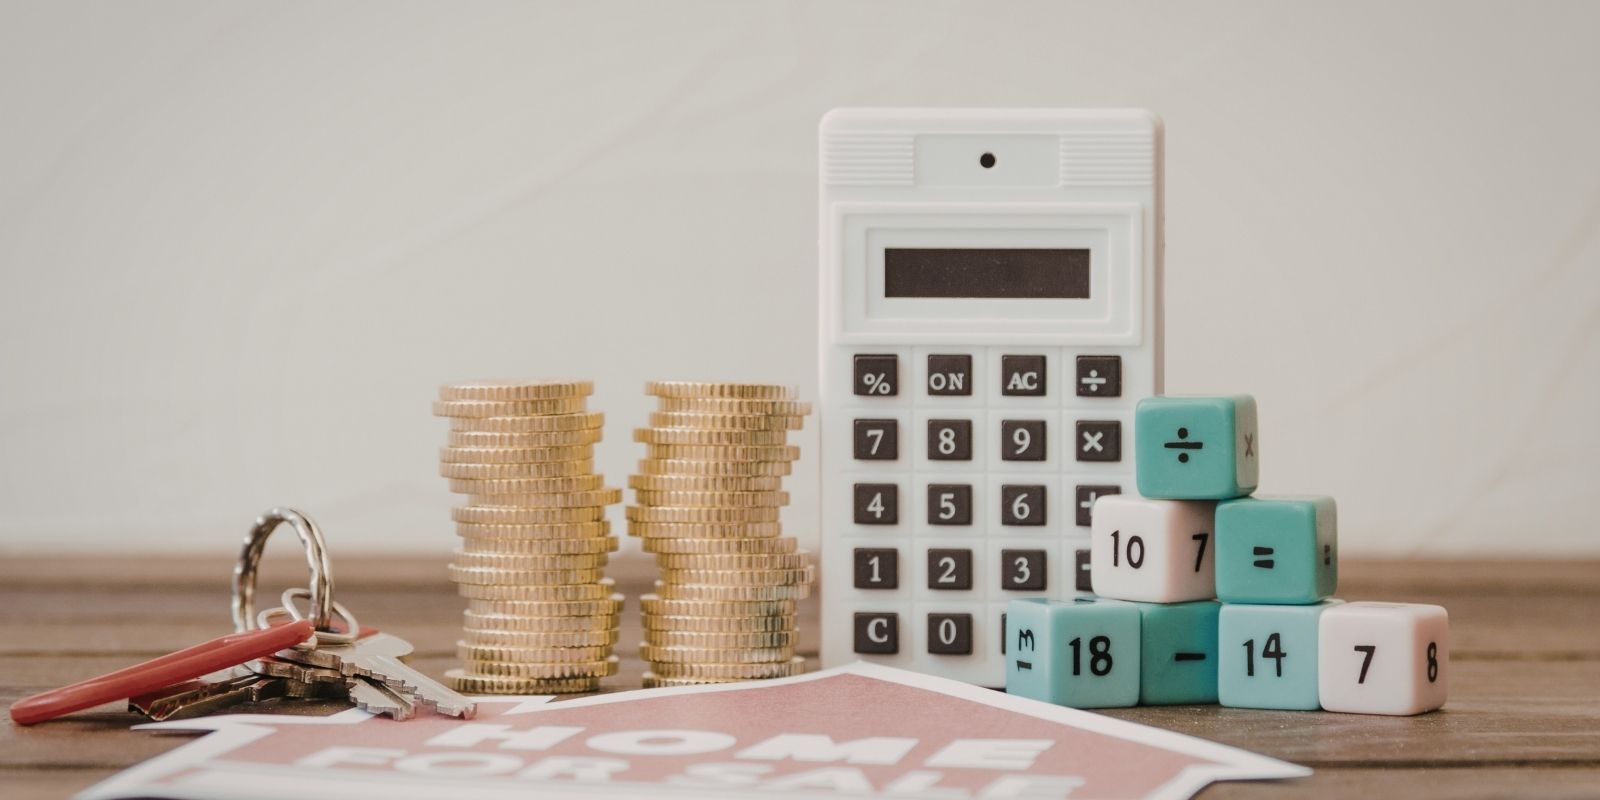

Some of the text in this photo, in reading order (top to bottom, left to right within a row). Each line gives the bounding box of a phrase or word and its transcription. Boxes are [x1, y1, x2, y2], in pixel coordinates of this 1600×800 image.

[929, 372, 965, 391] ON
[1006, 371, 1038, 391] AC
[866, 429, 884, 455] 7
[938, 427, 956, 455] 8
[1012, 427, 1031, 455] 9
[866, 492, 885, 519] 4
[939, 493, 956, 520] 5
[1012, 493, 1030, 520] 6
[869, 556, 1031, 584] 1 2 3
[1110, 529, 1145, 570] 10
[1191, 532, 1210, 573] 7
[867, 617, 957, 645] C 0
[1016, 628, 1035, 671] 13
[1068, 635, 1114, 677] 18
[1242, 632, 1287, 678] 14
[1353, 645, 1376, 685] 7
[1426, 641, 1438, 684] 8
[423, 723, 1055, 769] HOME
[292, 746, 1086, 800] FOR SALE
